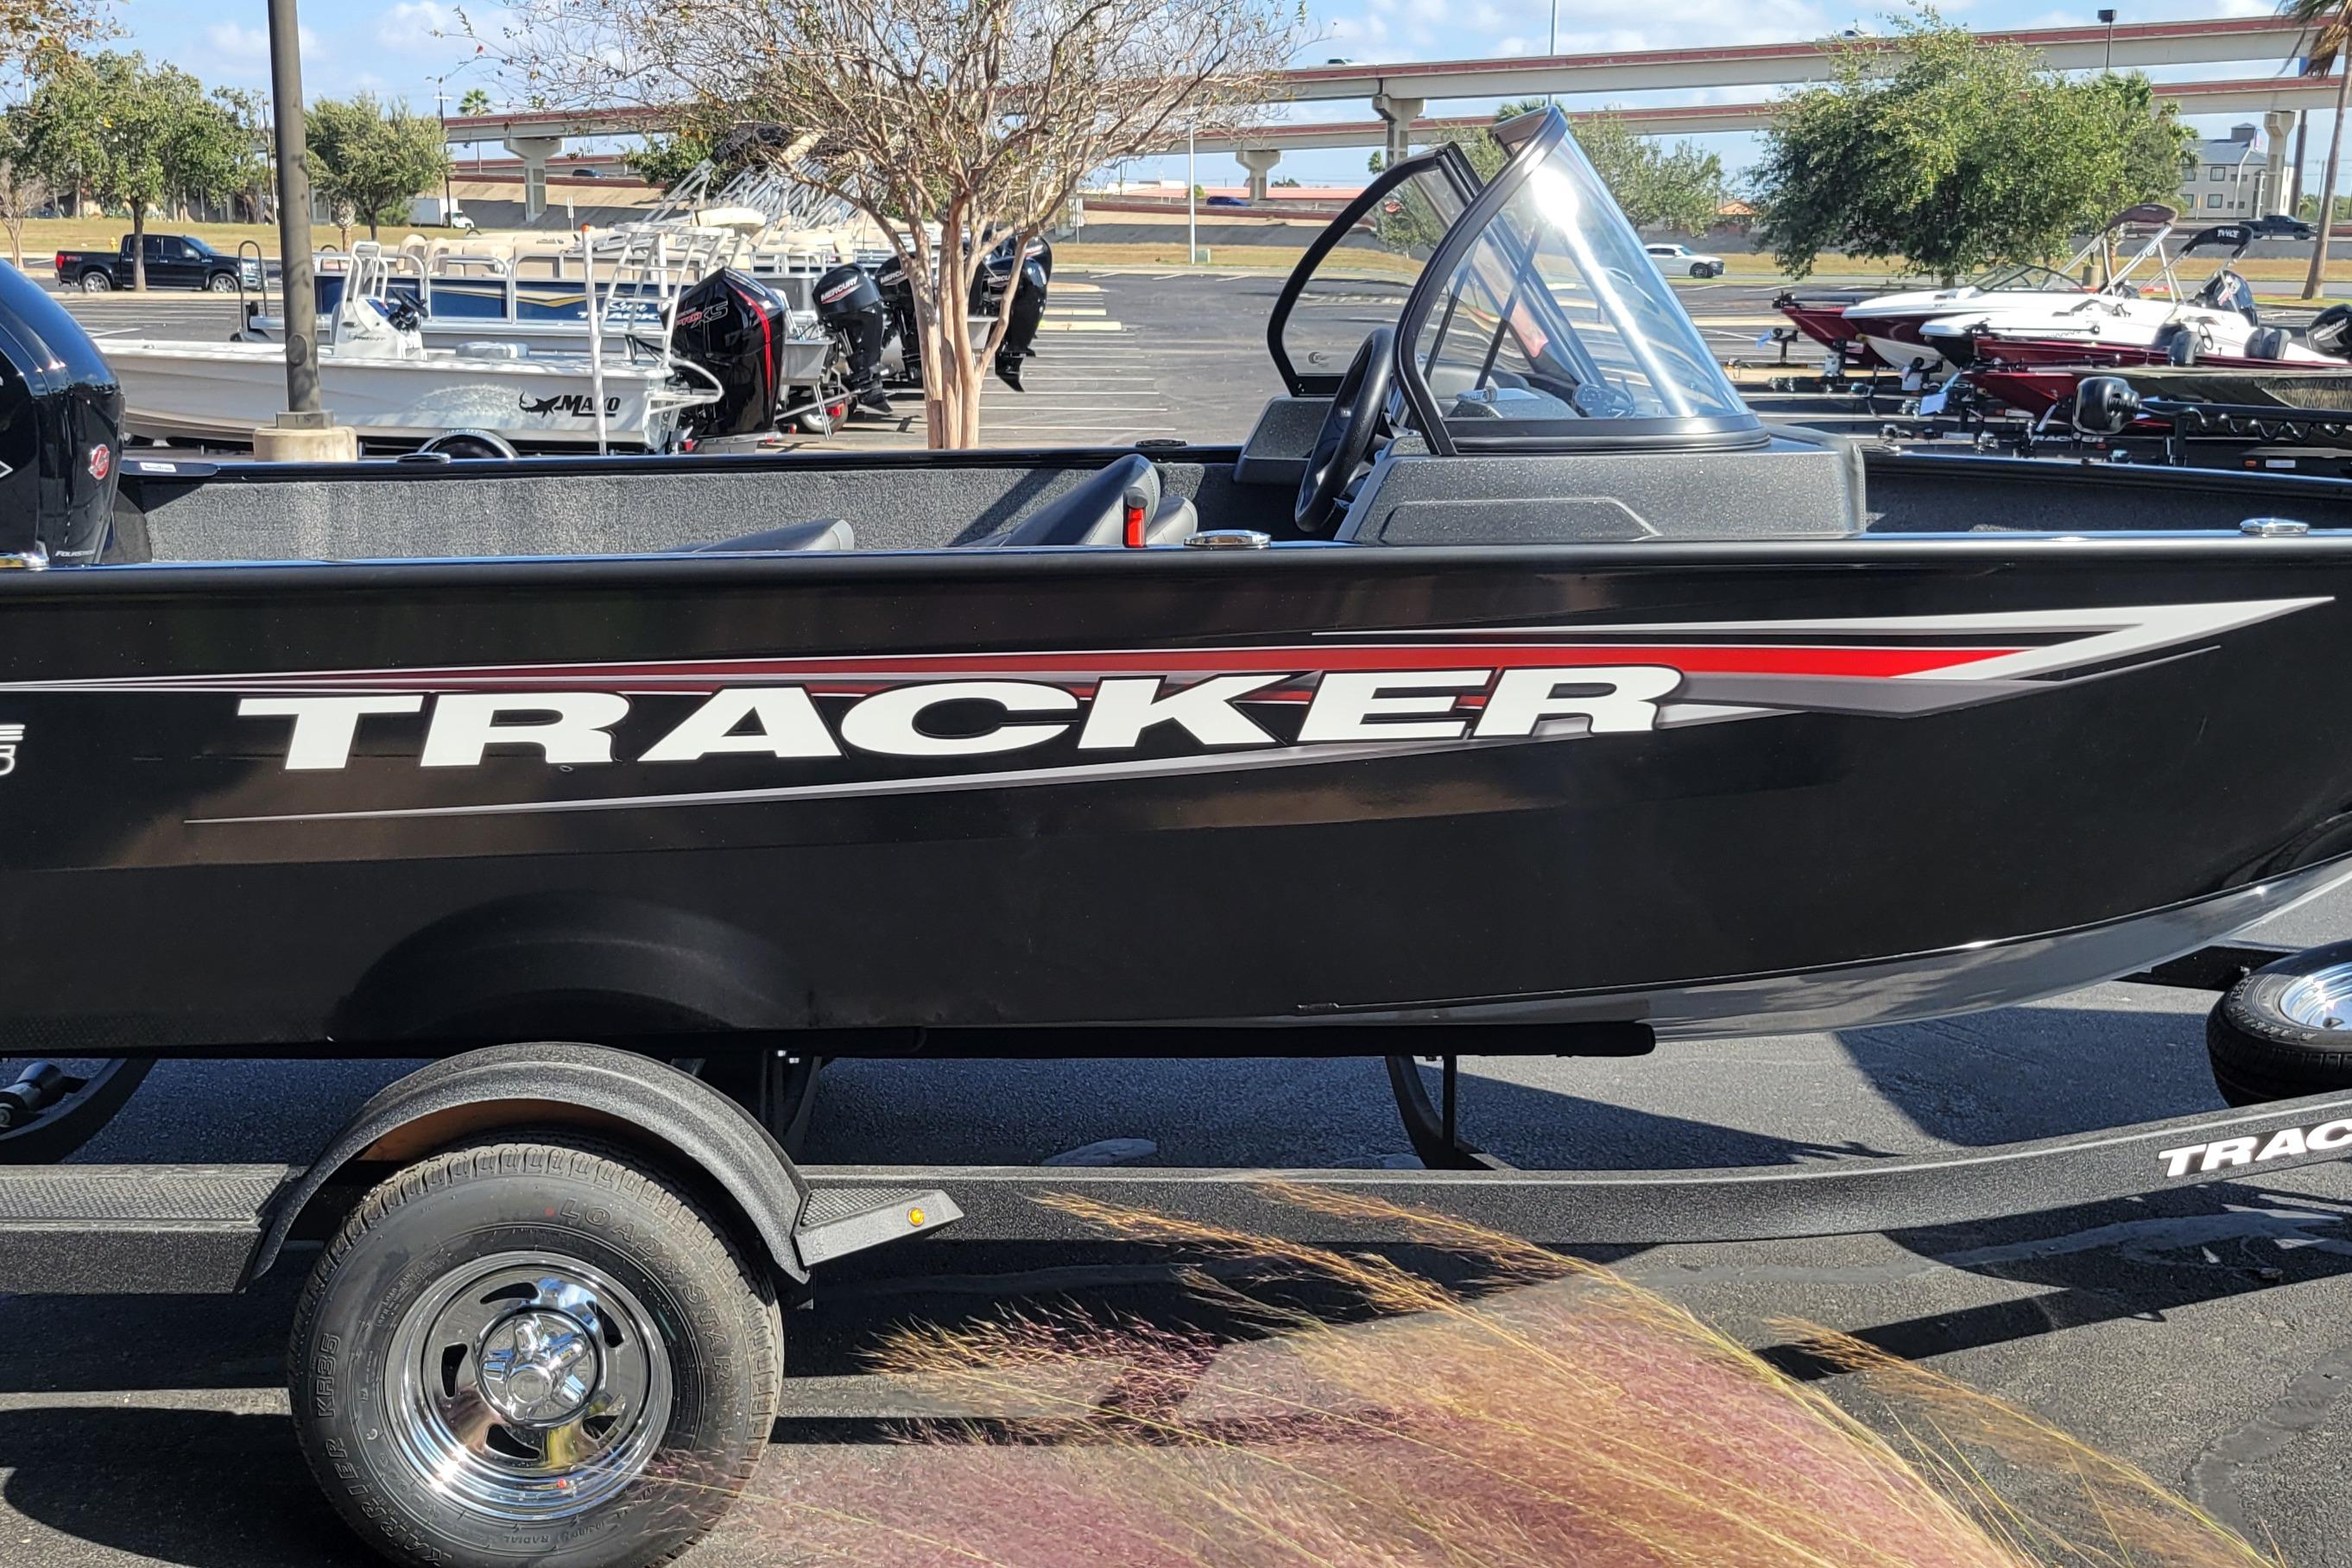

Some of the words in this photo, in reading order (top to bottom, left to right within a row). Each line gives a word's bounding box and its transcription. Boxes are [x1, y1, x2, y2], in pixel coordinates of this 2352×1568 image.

[821, 276, 859, 301] MERCURY
[553, 395, 622, 417] MAO
[238, 667, 1681, 770] TRACKER
[560, 1198, 663, 1258] LOAD
[682, 1284, 732, 1382] STAR
[317, 1333, 341, 1419] KR35
[325, 1436, 452, 1568] KARRIER
